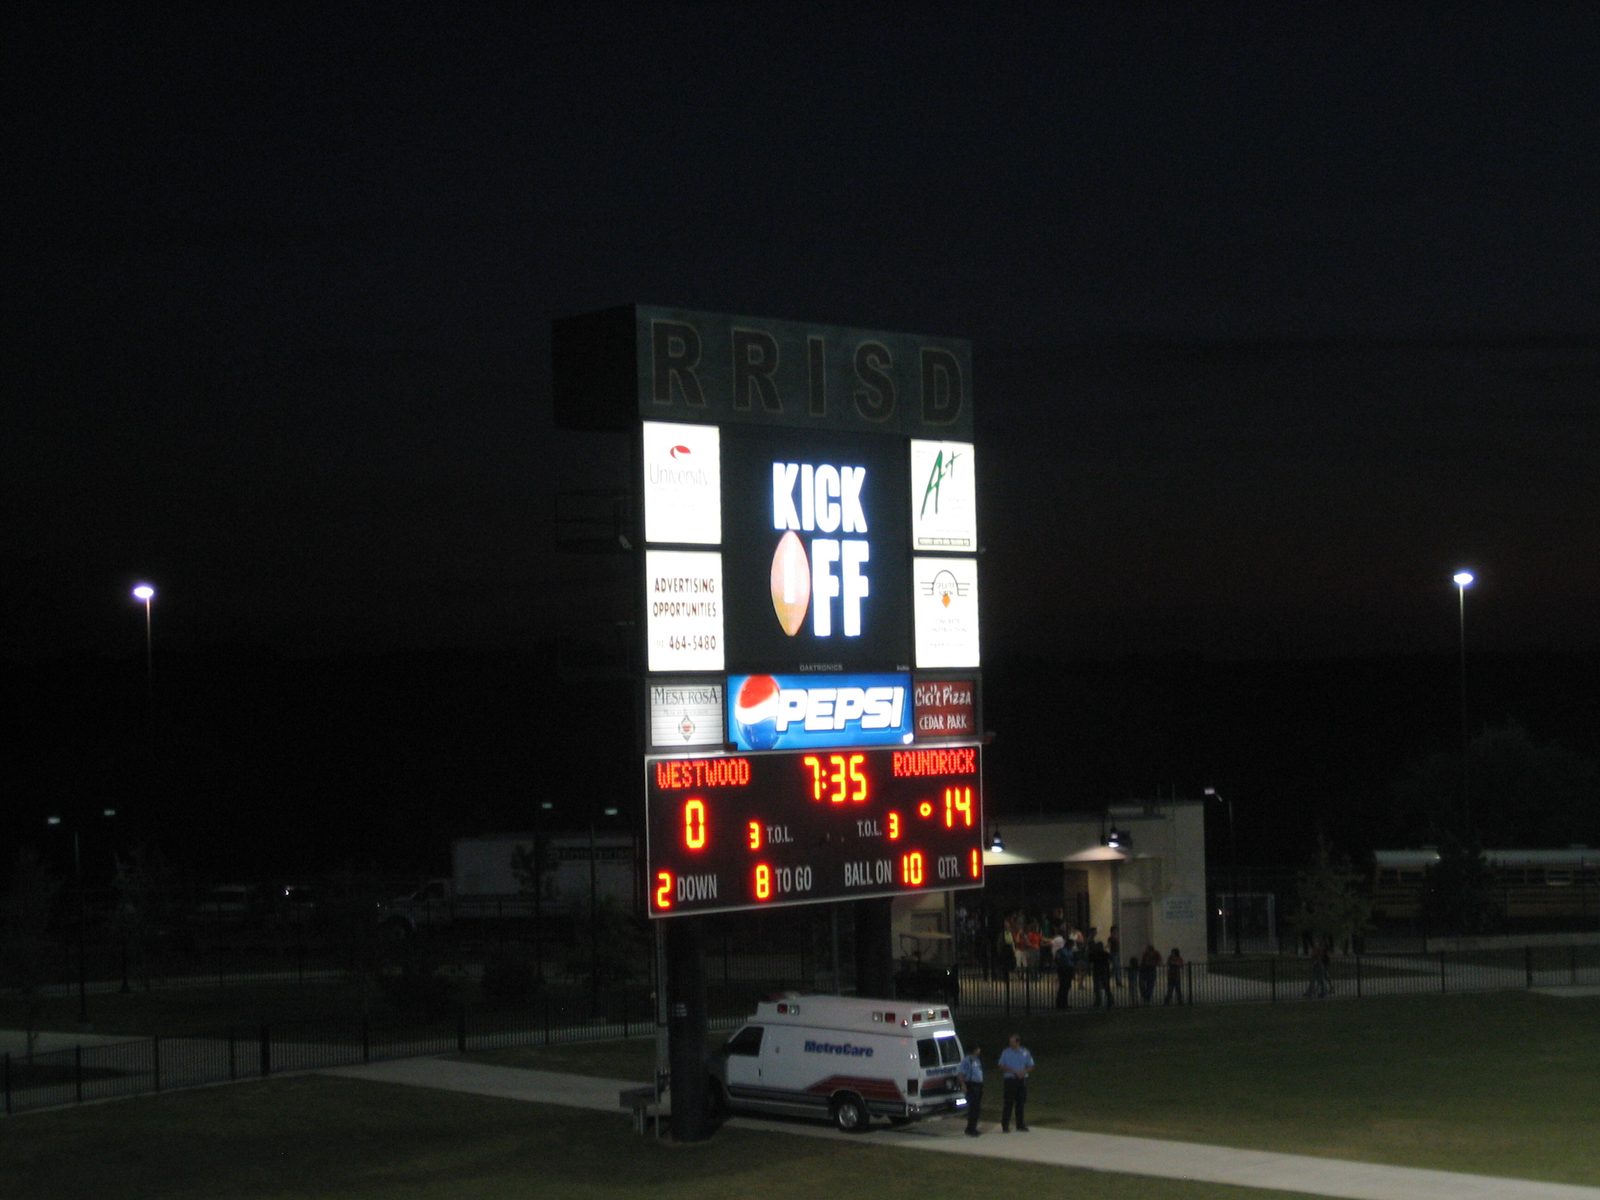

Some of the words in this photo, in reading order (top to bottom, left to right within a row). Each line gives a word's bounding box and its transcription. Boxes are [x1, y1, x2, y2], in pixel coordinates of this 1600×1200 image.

[651, 319, 964, 426] RRISD
[772, 462, 868, 533] KICK
[654, 577, 715, 593] ADVERTISING
[652, 601, 717, 618] OPPORTUNITIES
[669, 635, 717, 651] 464-5480
[654, 687, 685, 705] MESA
[688, 687, 718, 705] ROSA
[776, 686, 905, 732] PEPSI
[943, 684, 972, 706] Pizza
[919, 714, 944, 730] CEDAR
[947, 713, 967, 730] PARK
[657, 758, 751, 789] WESTWOOD
[893, 748, 976, 777] ROUNDROCK
[803, 754, 867, 802] 7:35
[944, 786, 972, 828] 14
[685, 798, 706, 849] 0
[749, 821, 760, 849] 3
[766, 825, 794, 844] T.O.L.
[857, 820, 882, 837] T.O.L.
[888, 812, 899, 839] 3
[844, 862, 873, 888] BALL
[875, 859, 892, 885] ON
[903, 852, 922, 885] 10
[971, 848, 979, 878] 1
[657, 871, 671, 908] 2
[677, 874, 718, 902] DOWN
[755, 864, 770, 899] 8
[775, 867, 792, 894] TO
[795, 865, 812, 892] GO
[804, 1040, 874, 1058] MetroCare
